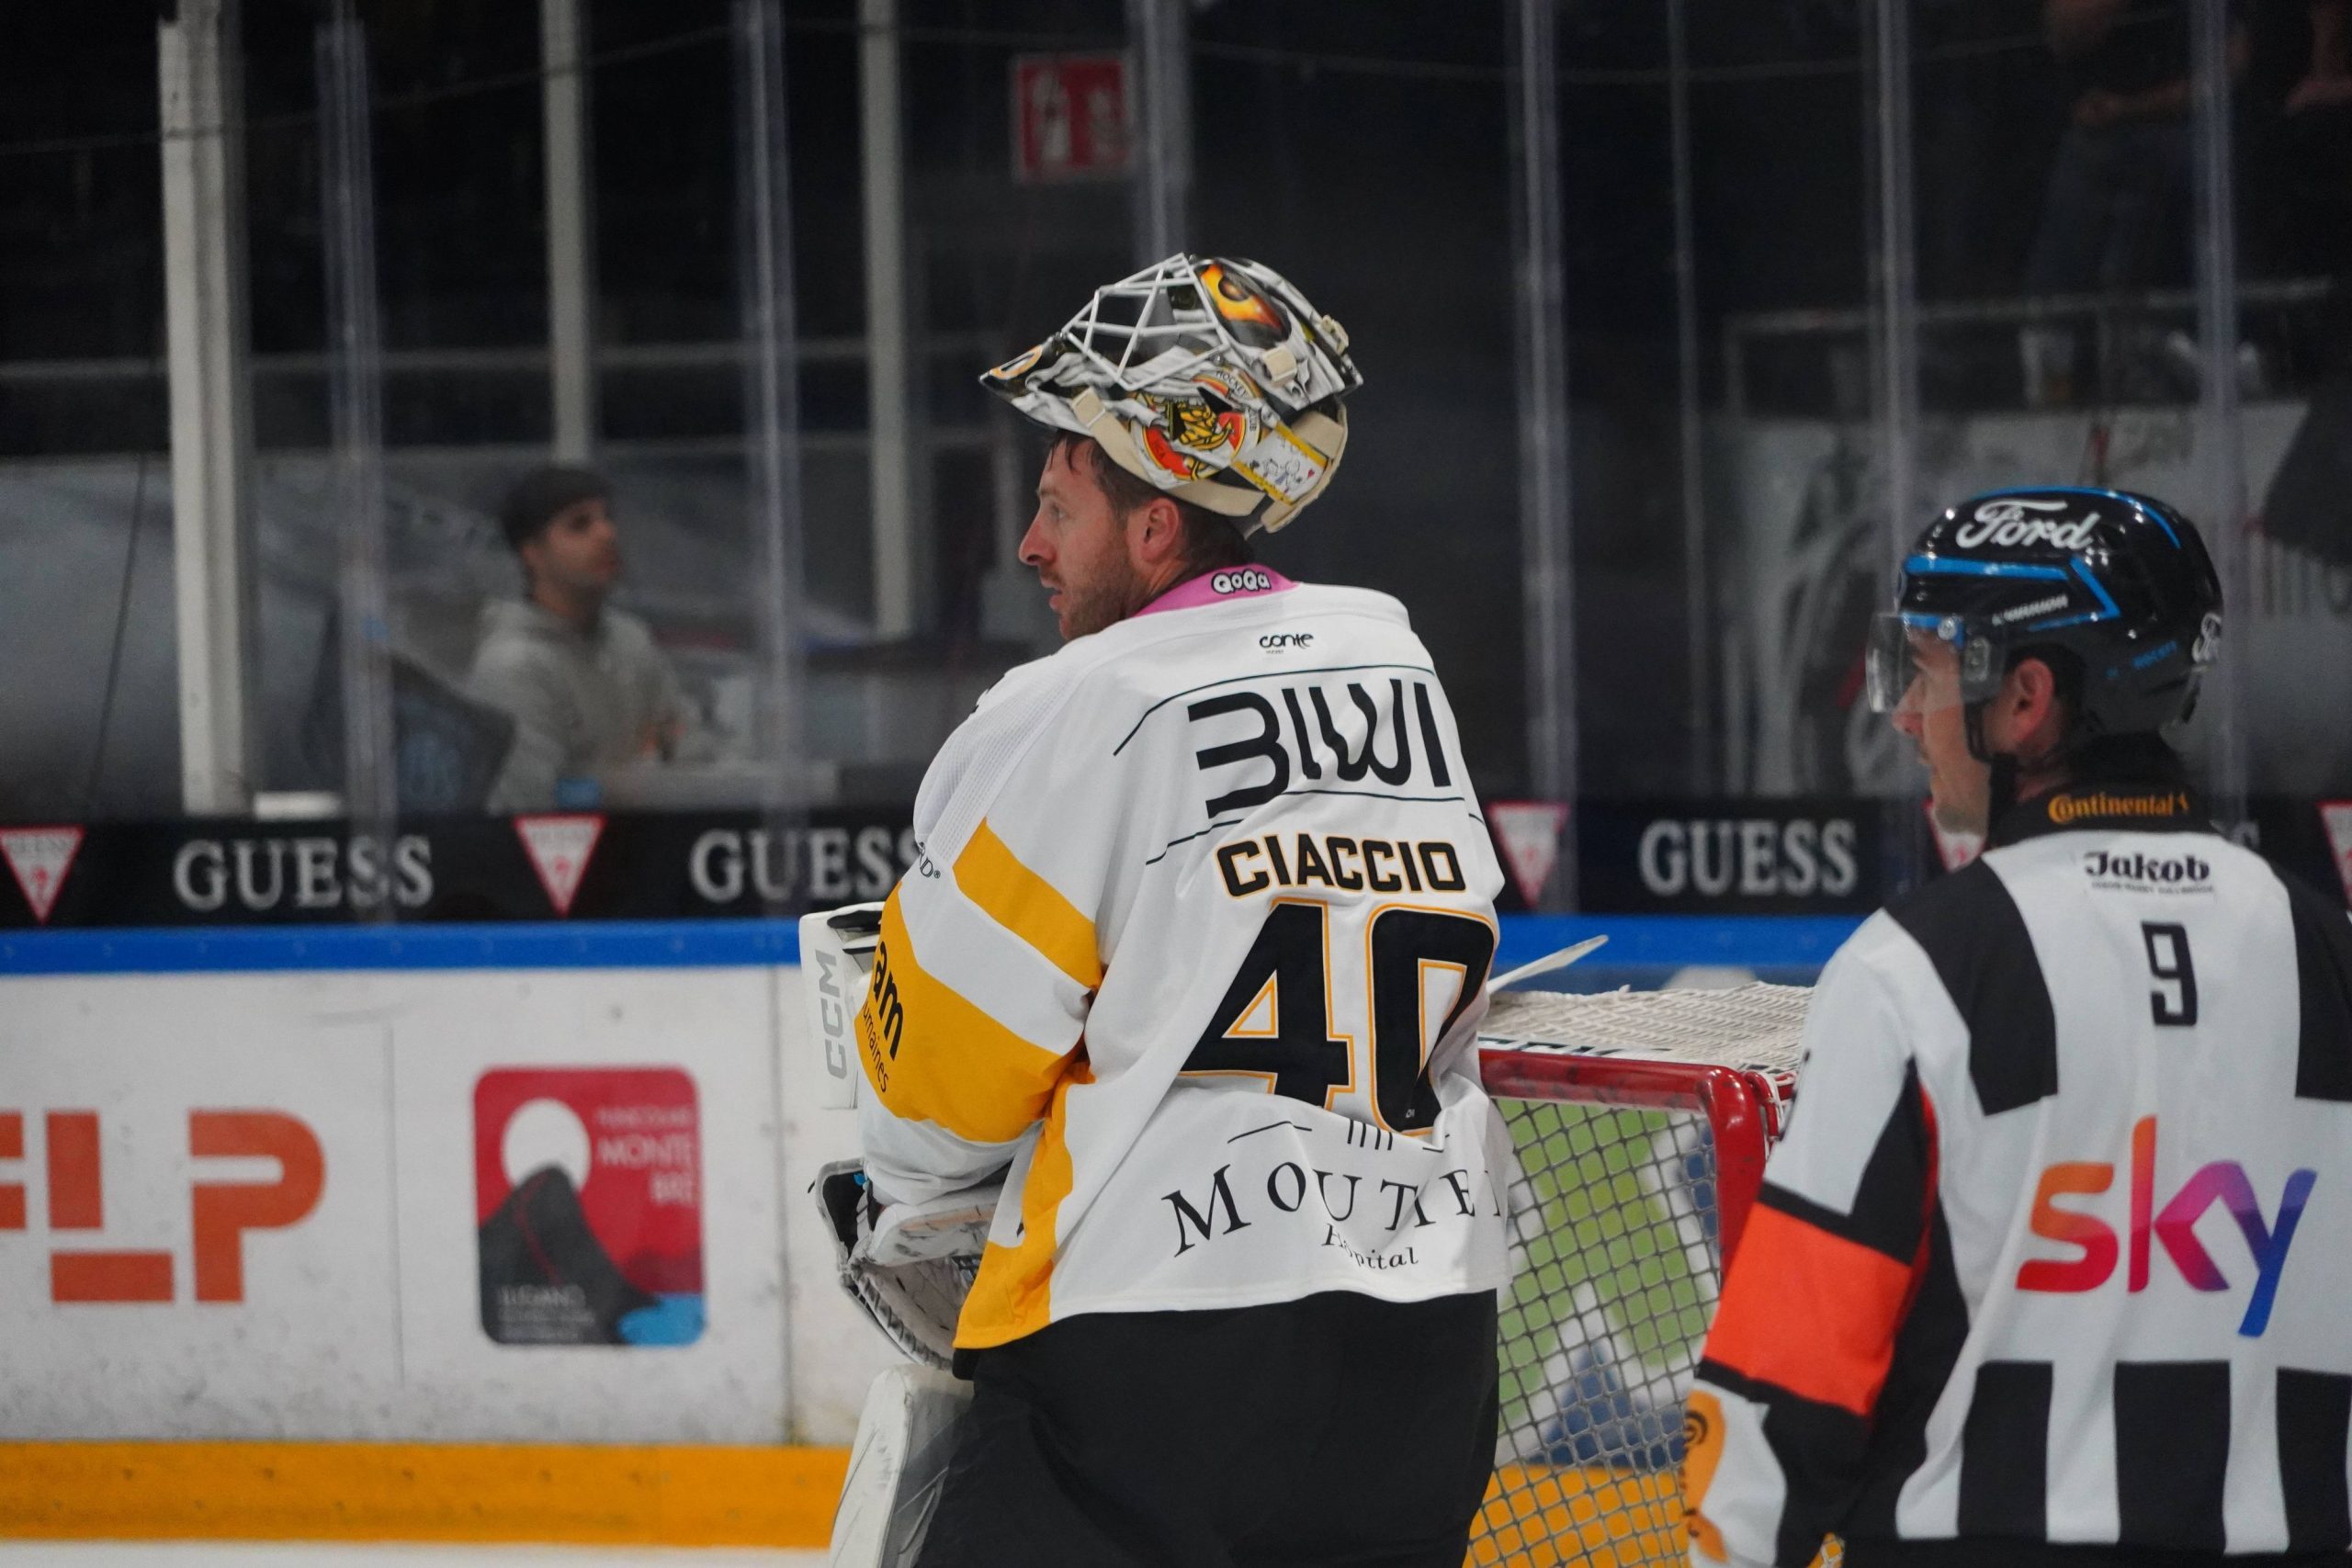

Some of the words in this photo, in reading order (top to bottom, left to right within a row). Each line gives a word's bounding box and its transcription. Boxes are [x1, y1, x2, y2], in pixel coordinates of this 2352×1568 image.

[1955, 498, 2101, 550] Ford
[1211, 569, 1272, 595] QoQa
[2047, 792, 2175, 824] Continental
[173, 834, 434, 910] GUESS
[1214, 831, 1467, 898] CIACCIO
[1639, 819, 1858, 897] GUESS
[2084, 851, 2211, 883] Jakob
[2142, 921, 2199, 1028] 9
[815, 949, 848, 1080] CCM
[1176, 896, 1499, 1139] 40
[2015, 1113, 2319, 1338] sky
